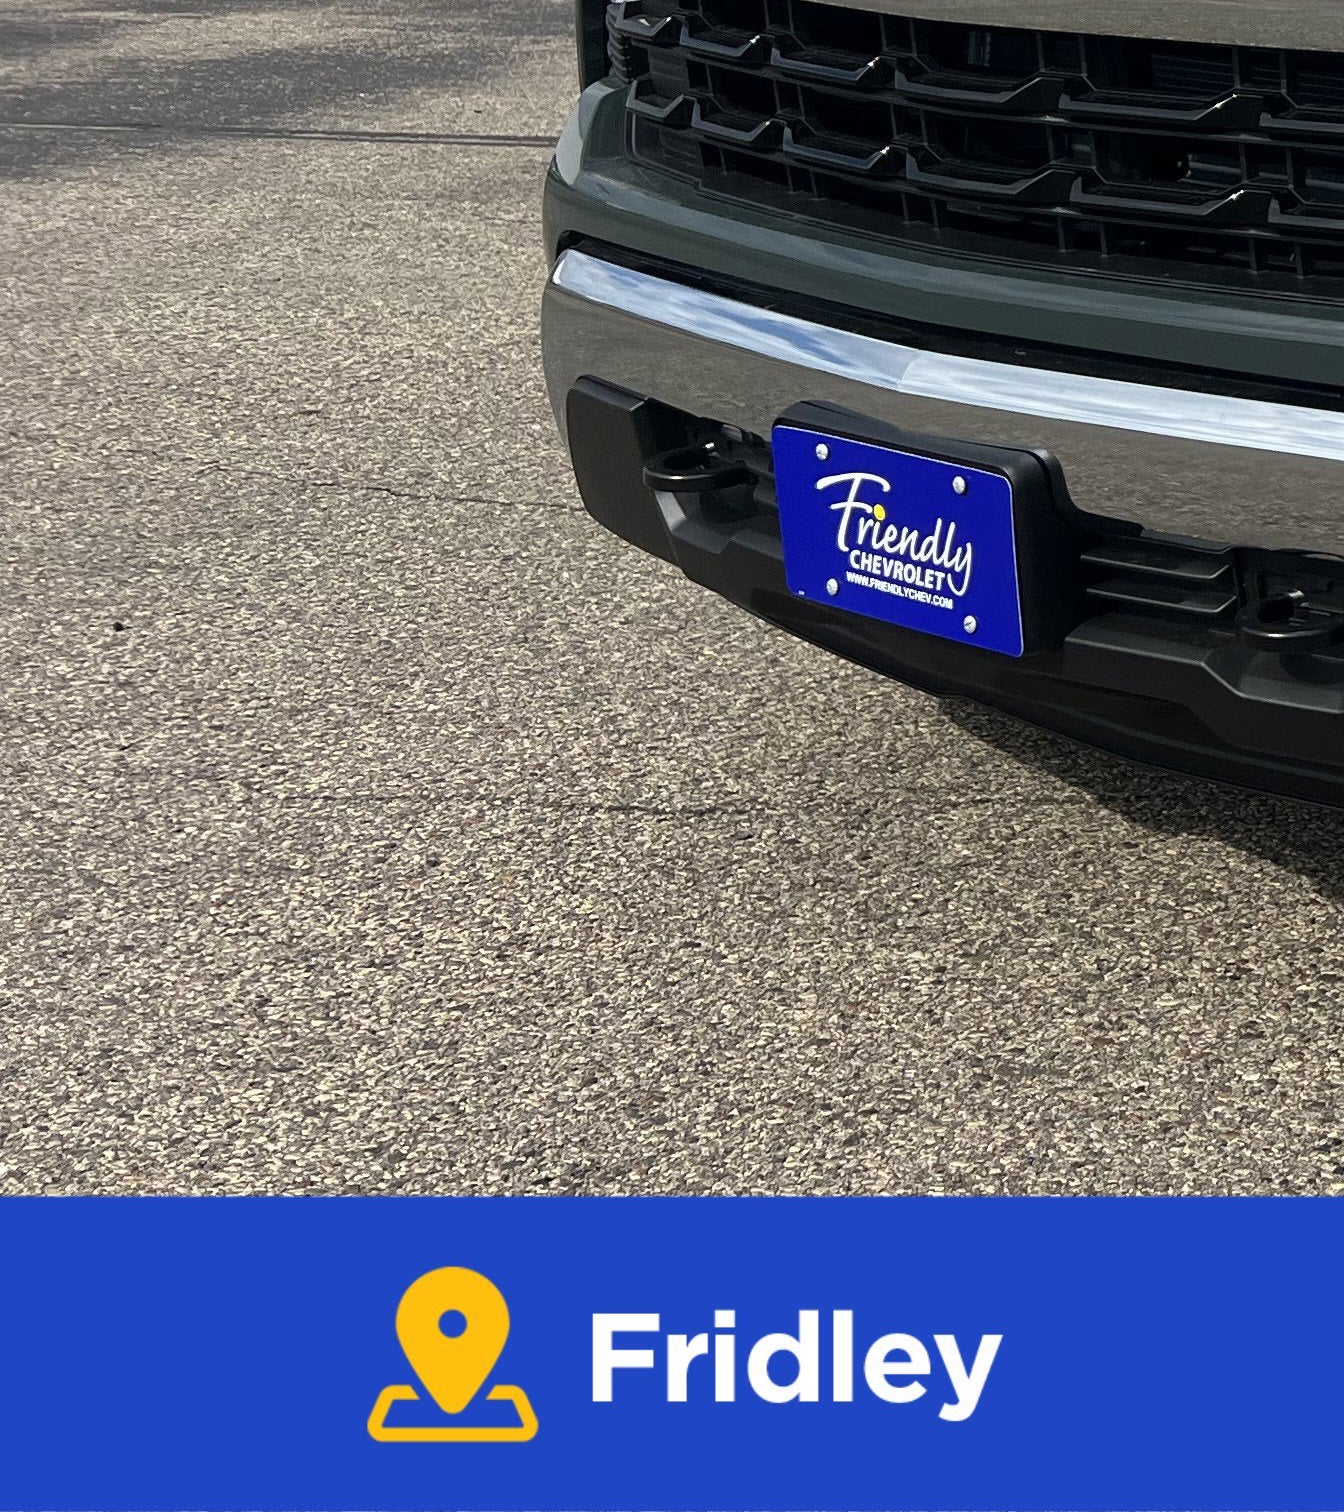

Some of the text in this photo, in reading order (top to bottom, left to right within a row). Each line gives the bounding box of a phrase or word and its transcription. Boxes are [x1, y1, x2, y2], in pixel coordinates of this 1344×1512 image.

[816, 472, 973, 597] Friendly
[845, 571, 954, 610] WWW.FRIENDLYCHEV.COM
[849, 549, 946, 591] CHEVROLET
